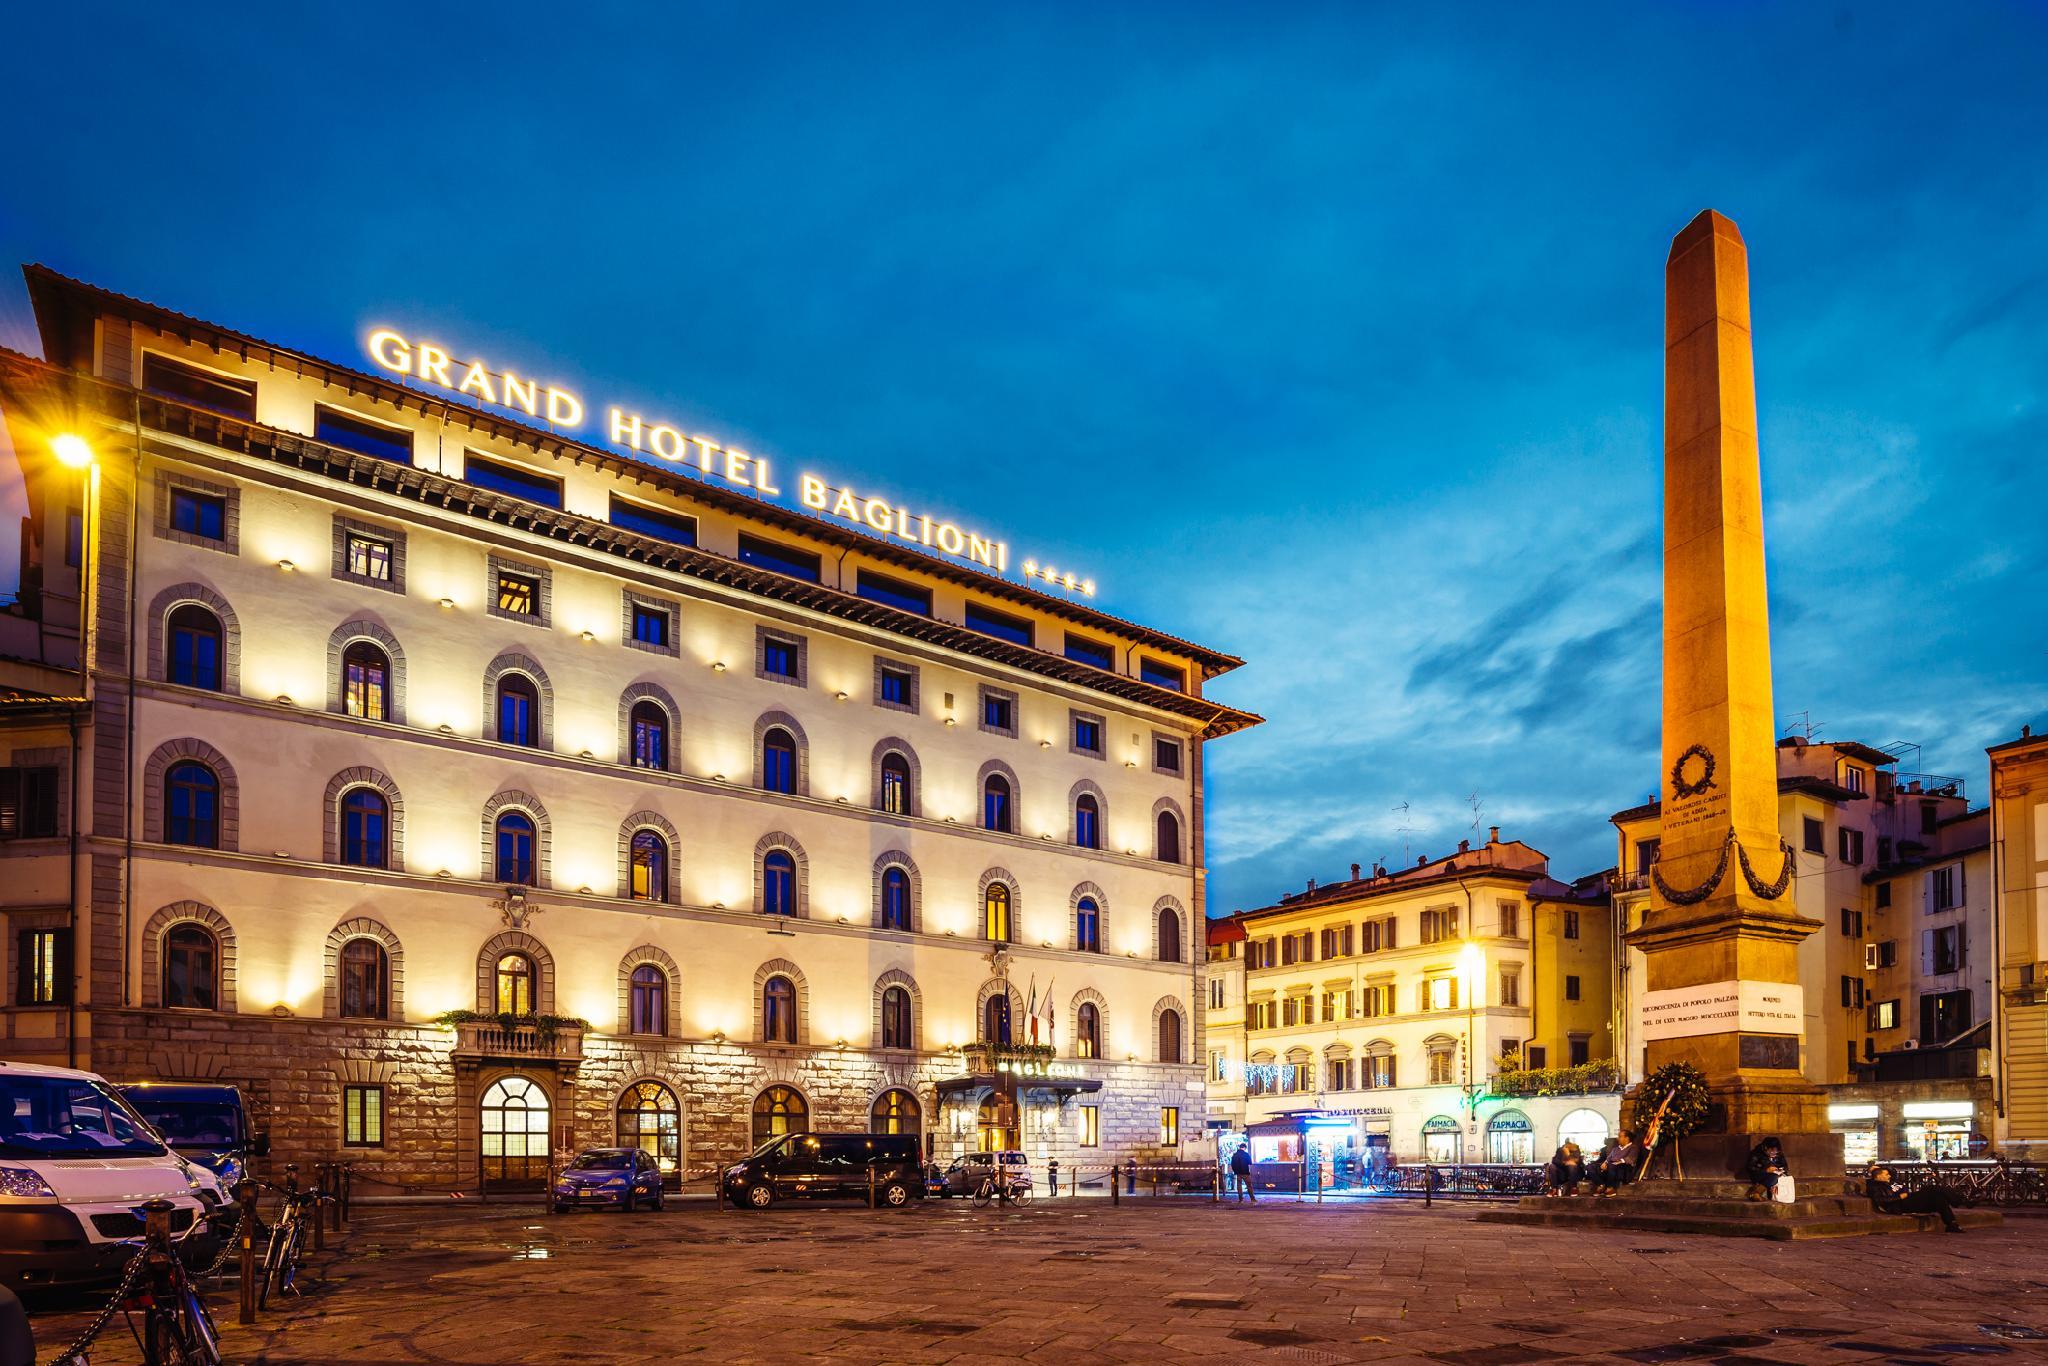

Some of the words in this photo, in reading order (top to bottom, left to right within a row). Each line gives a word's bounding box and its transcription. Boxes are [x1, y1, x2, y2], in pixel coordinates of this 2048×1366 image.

[369, 331, 584, 427] GRAND
[611, 408, 780, 495] HOTEL
[802, 474, 1008, 572] BAGLIONI
[998, 1062, 1084, 1077] BAGLIONI
[1427, 1119, 1457, 1128] FARMACIA
[1492, 1120, 1528, 1129] FARMACIA
